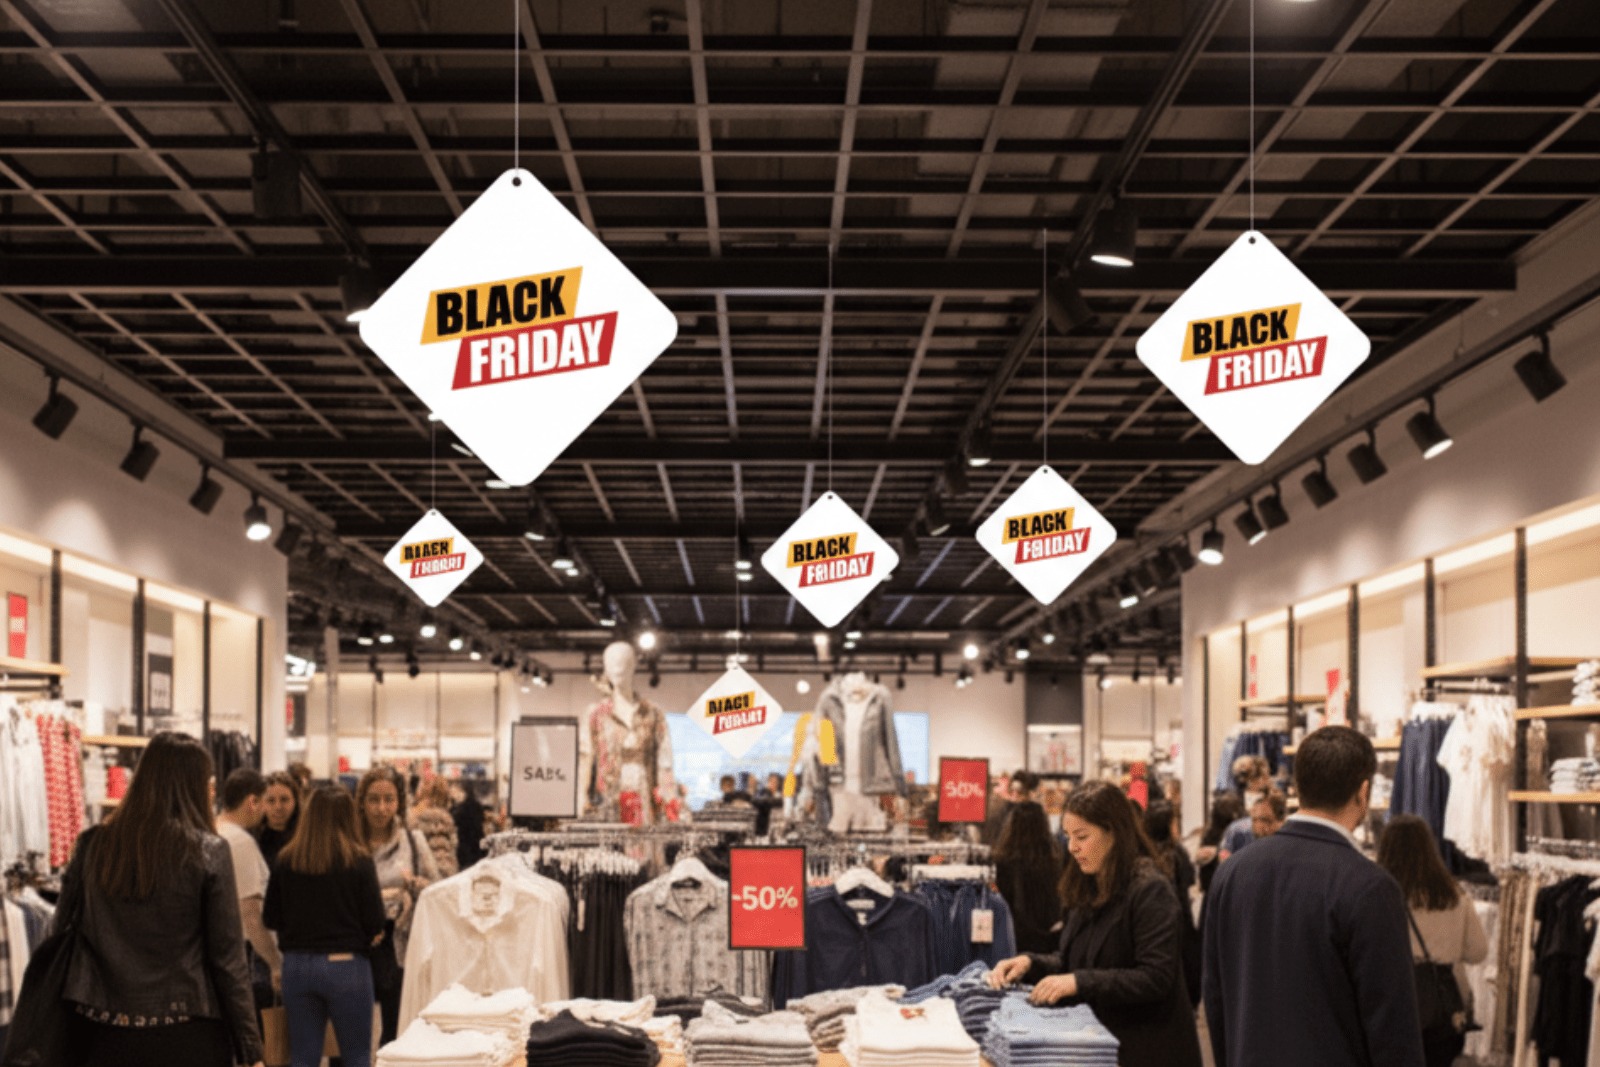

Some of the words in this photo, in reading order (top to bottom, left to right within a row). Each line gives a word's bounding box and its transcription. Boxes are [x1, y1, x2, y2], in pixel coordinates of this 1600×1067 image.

[436, 275, 566, 336] BLACK
[470, 319, 605, 384] FRIDAY
[1192, 309, 1289, 356] BLACK
[1217, 341, 1318, 390] FRIDAY
[1008, 510, 1067, 539] BLACK
[793, 536, 850, 563] BLACK
[806, 555, 869, 585] FRIDAY
[731, 885, 799, 911] -50%
